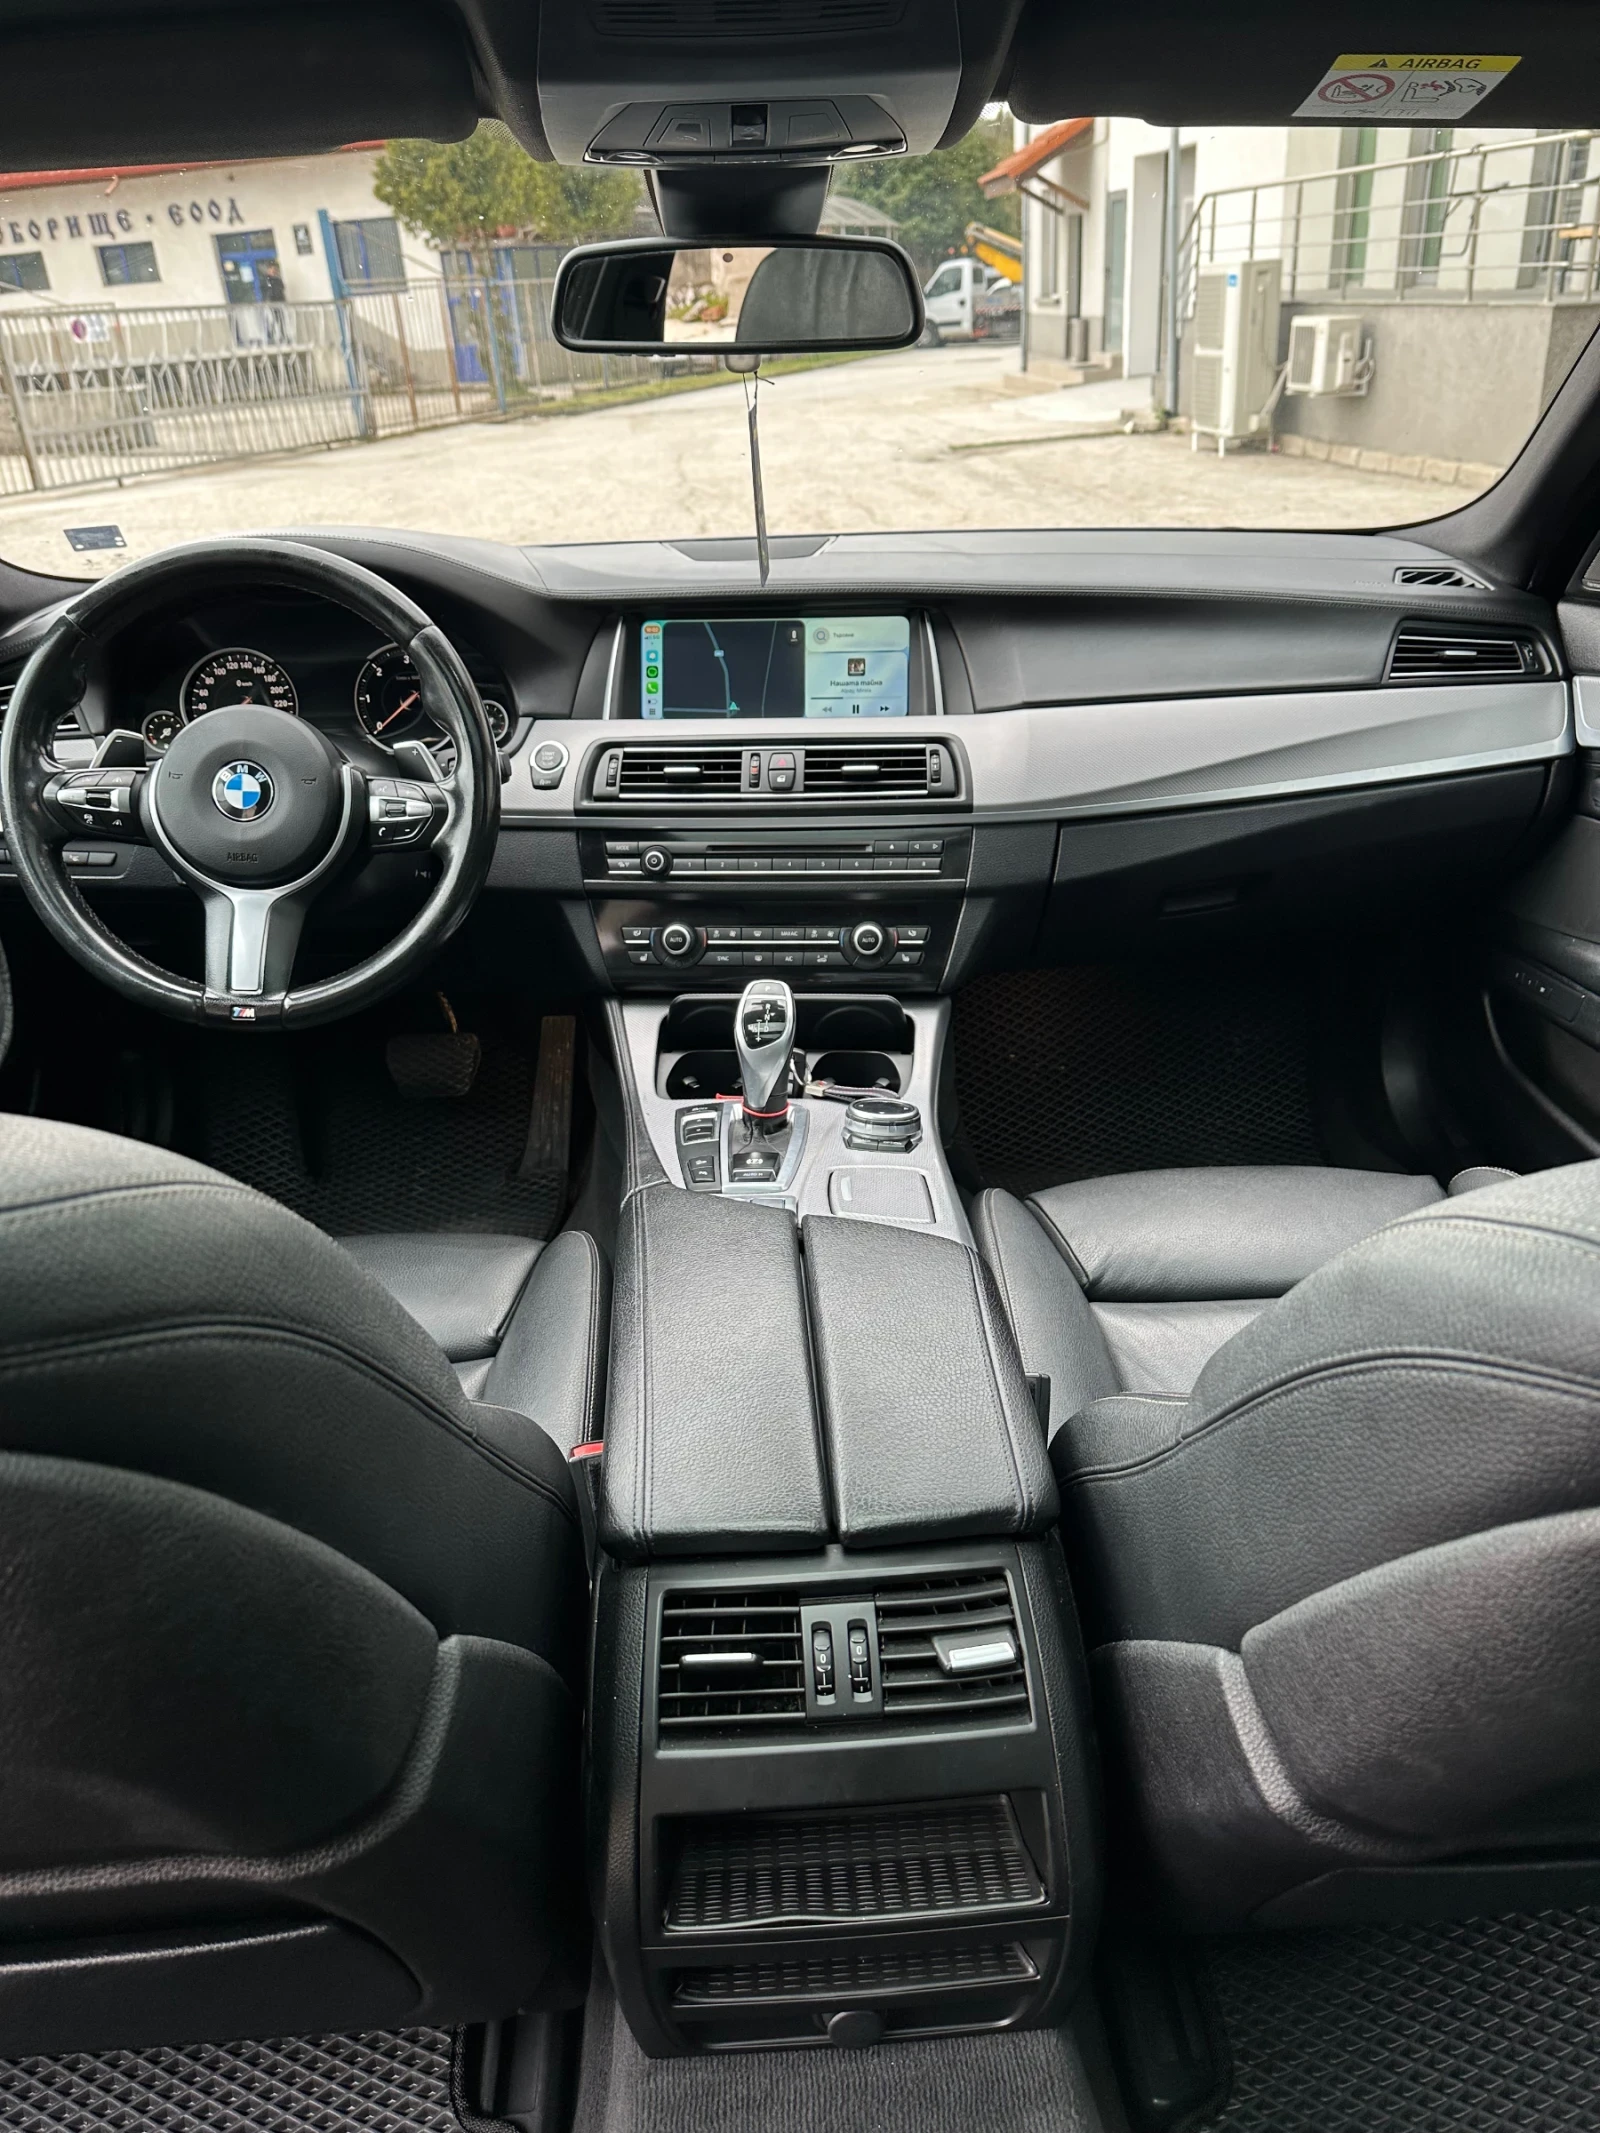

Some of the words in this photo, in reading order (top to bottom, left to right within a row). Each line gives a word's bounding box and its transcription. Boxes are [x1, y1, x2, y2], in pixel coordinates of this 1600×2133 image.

[1399, 58, 1482, 69] AIRBAG
[404, 655, 410, 664] 3
[226, 662, 238, 670] 120
[240, 661, 252, 669] 140
[214, 668, 226, 676] 100
[376, 668, 382, 676] 2
[270, 686, 284, 694] 200
[366, 694, 370, 703] 1
[274, 700, 288, 708] 220
[376, 721, 383, 730] 0
[219, 764, 268, 783] BMW
[227, 852, 259, 864] AIRBAG
[856, 1646, 862, 1655] 0
[820, 1654, 826, 1664] 0
